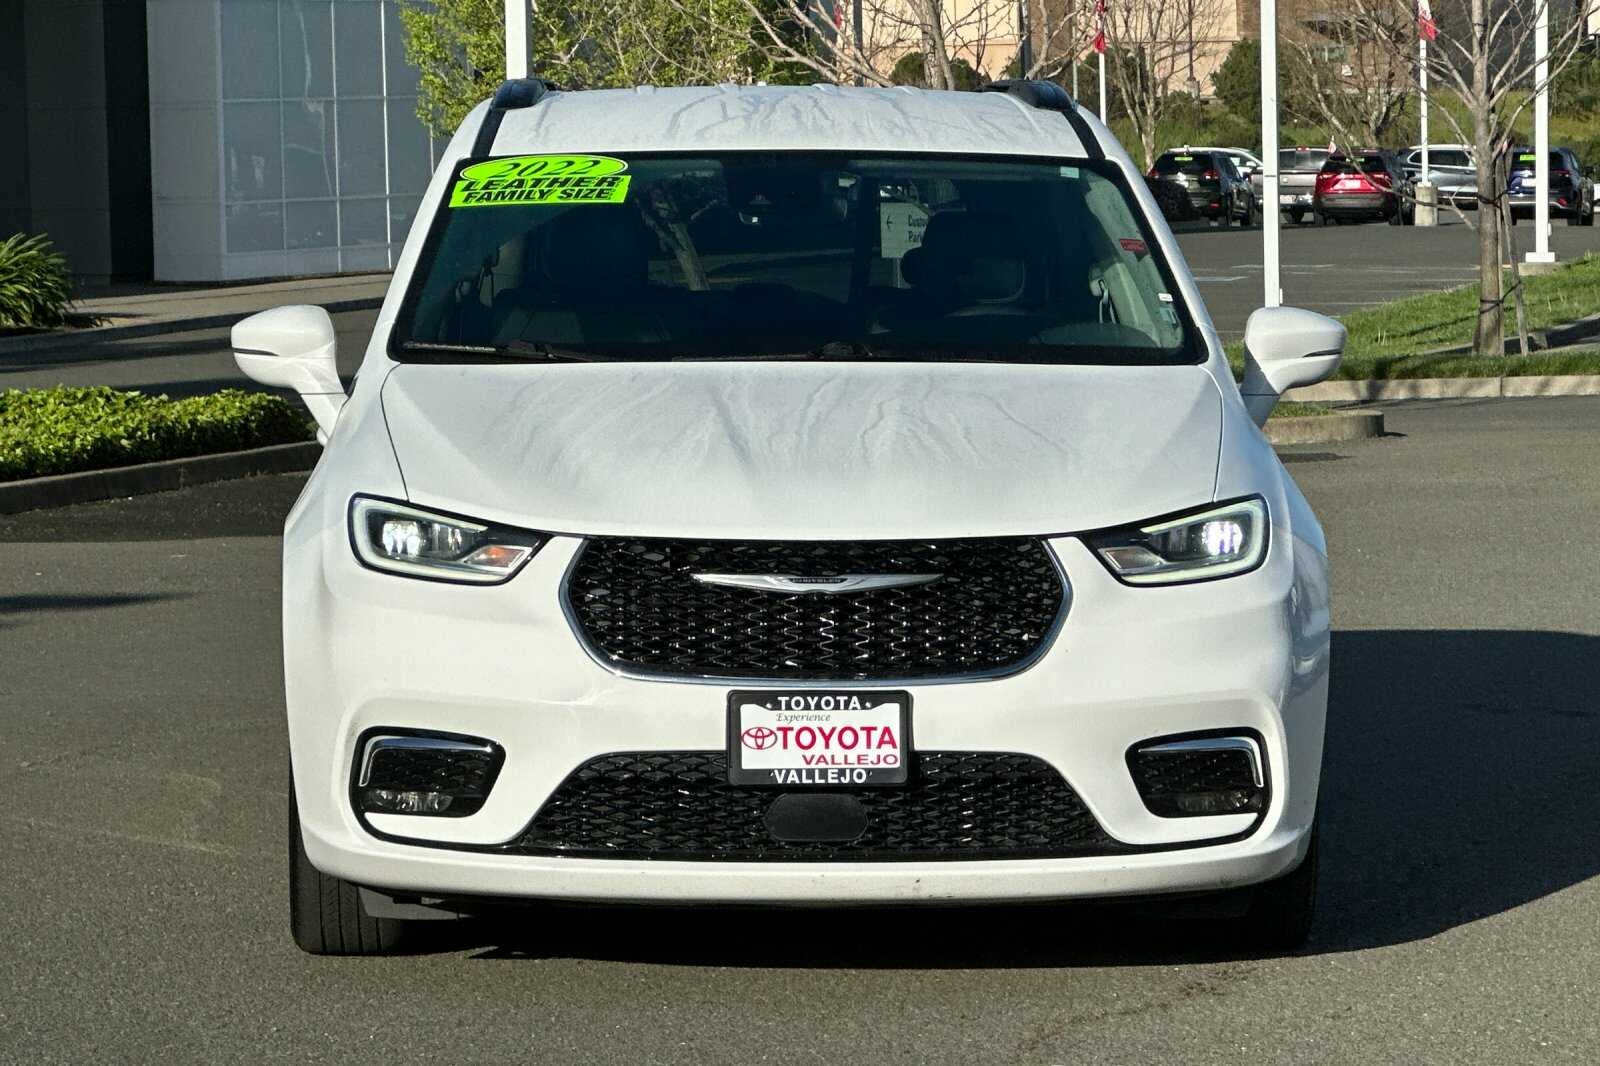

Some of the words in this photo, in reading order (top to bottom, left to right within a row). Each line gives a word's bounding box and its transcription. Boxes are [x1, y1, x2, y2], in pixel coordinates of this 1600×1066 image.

[488, 160, 601, 178] 2022
[461, 175, 619, 192] LEATHER
[463, 188, 550, 203] FAMILY
[557, 188, 611, 200] SIZE
[777, 696, 861, 711] TOYOTA
[775, 713, 831, 725] Experience
[776, 726, 898, 750] TOYOTA
[802, 754, 898, 766] VALLEJO
[774, 769, 867, 784] VALLEJO
